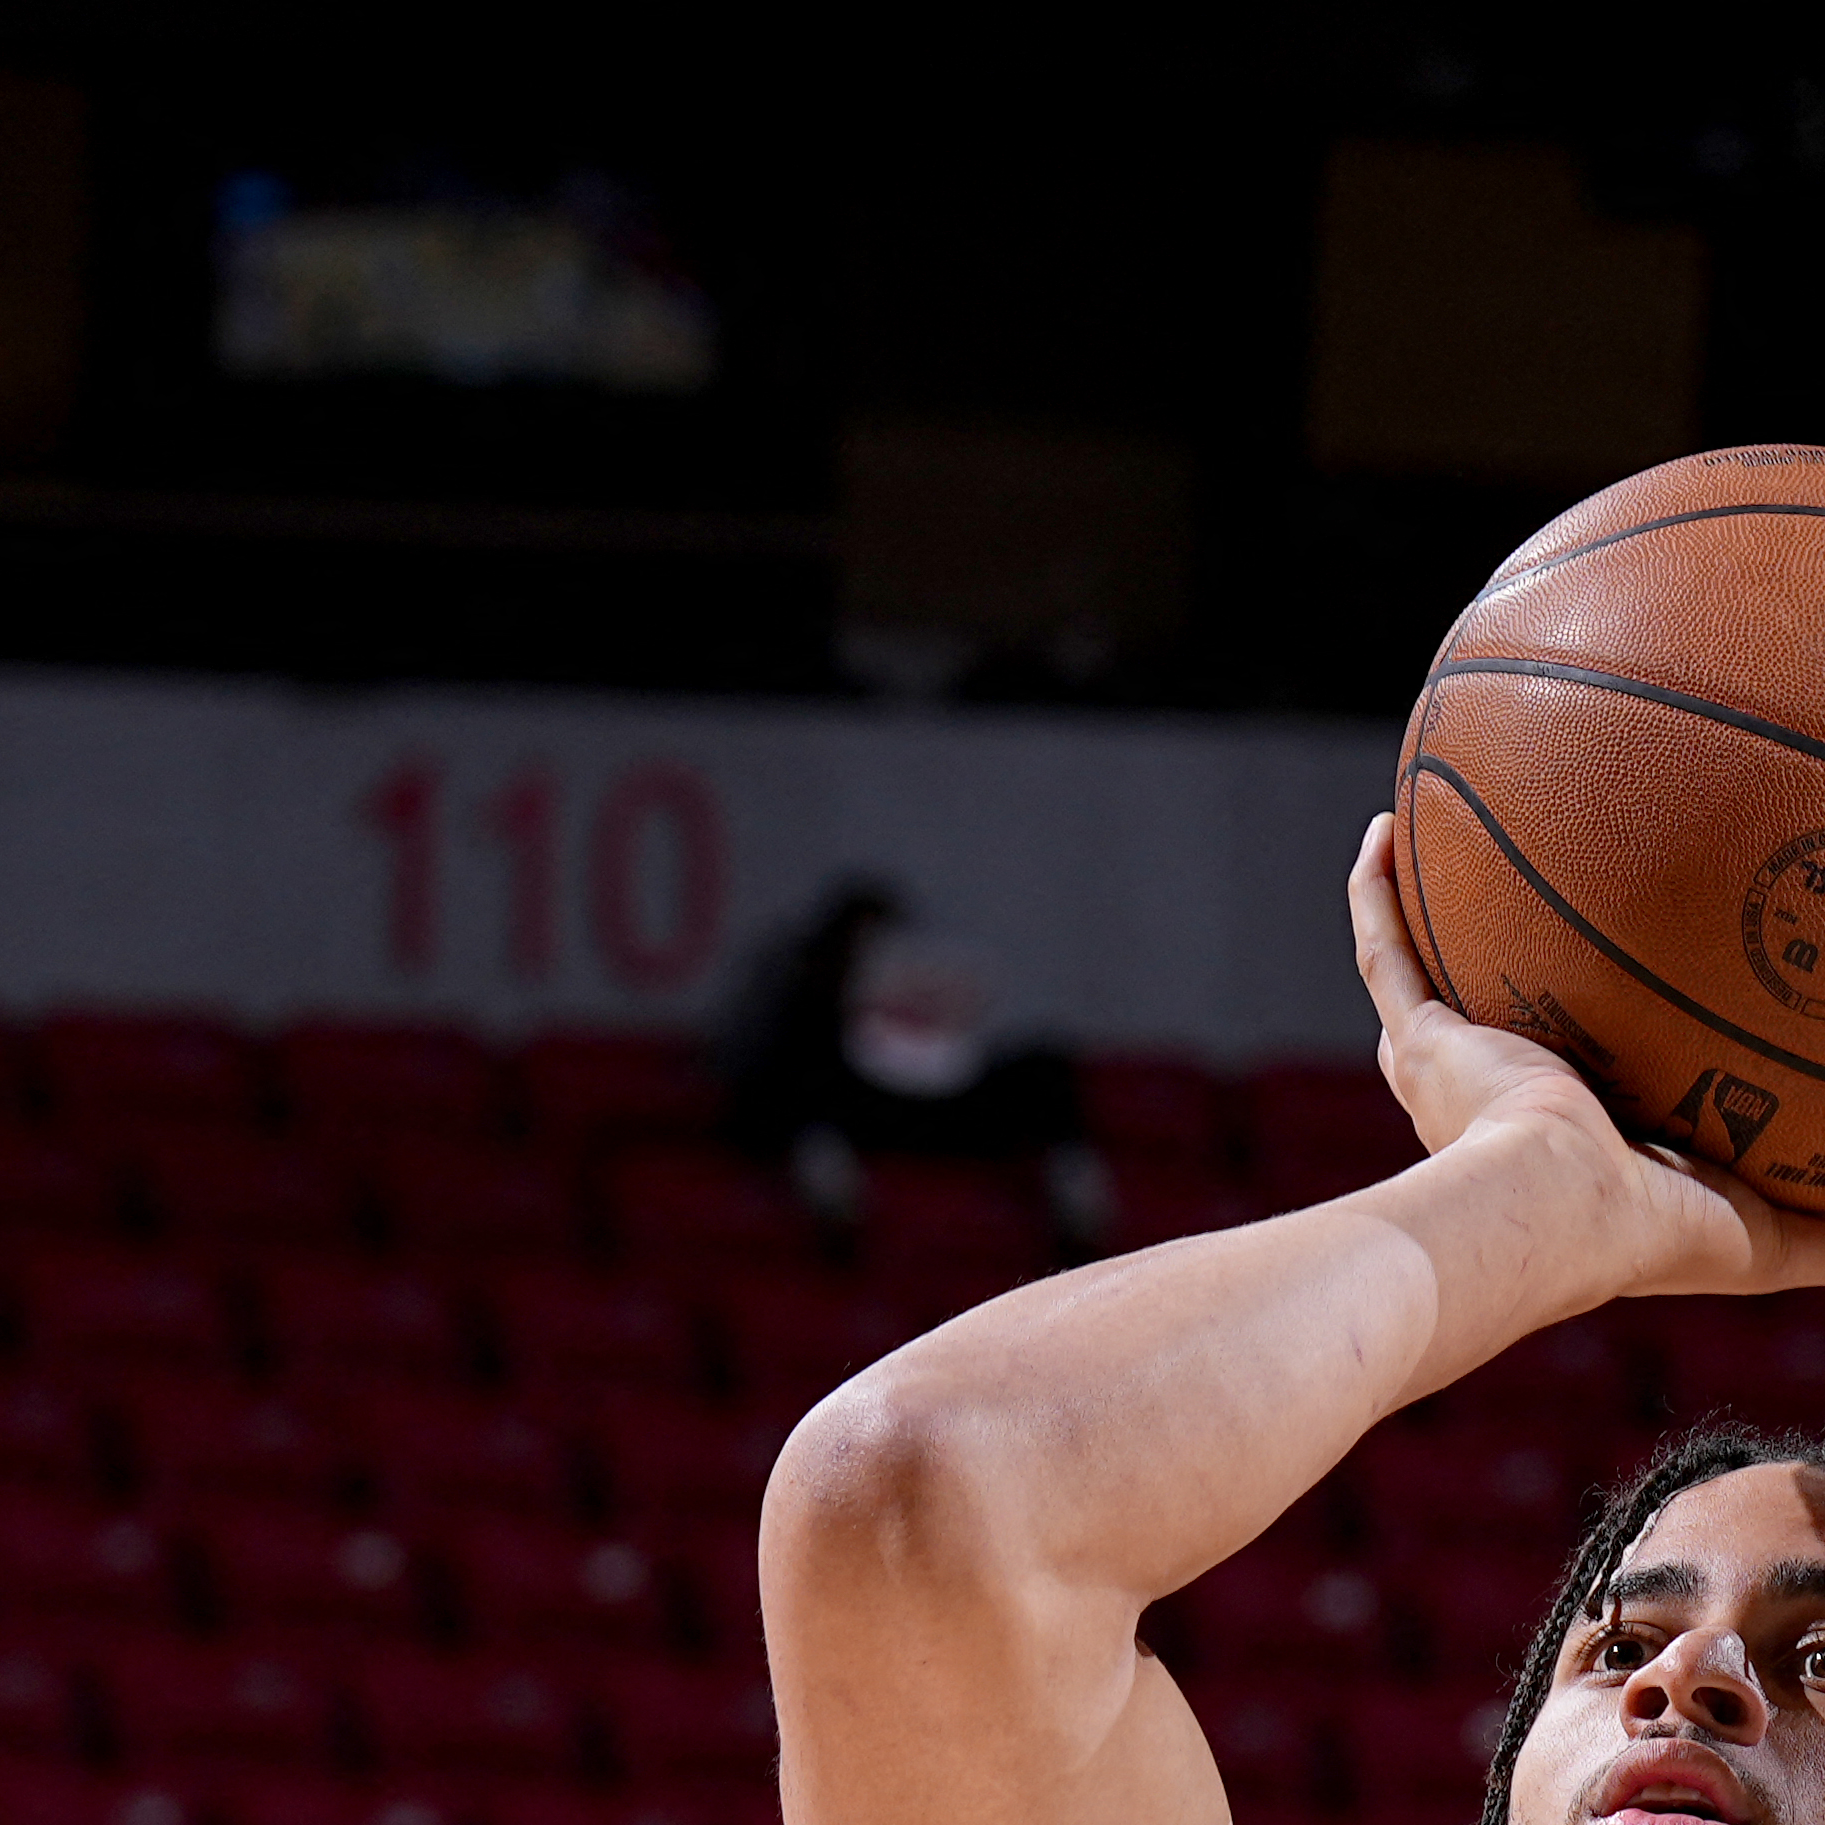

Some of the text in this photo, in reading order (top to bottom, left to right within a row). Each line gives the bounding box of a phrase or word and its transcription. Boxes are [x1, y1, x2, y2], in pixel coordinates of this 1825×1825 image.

[358, 744, 730, 994] 110
[1800, 836, 1817, 850] IN
[1538, 990, 1617, 1069] COMMISSIONER
[1724, 1085, 1770, 1121] NBA
